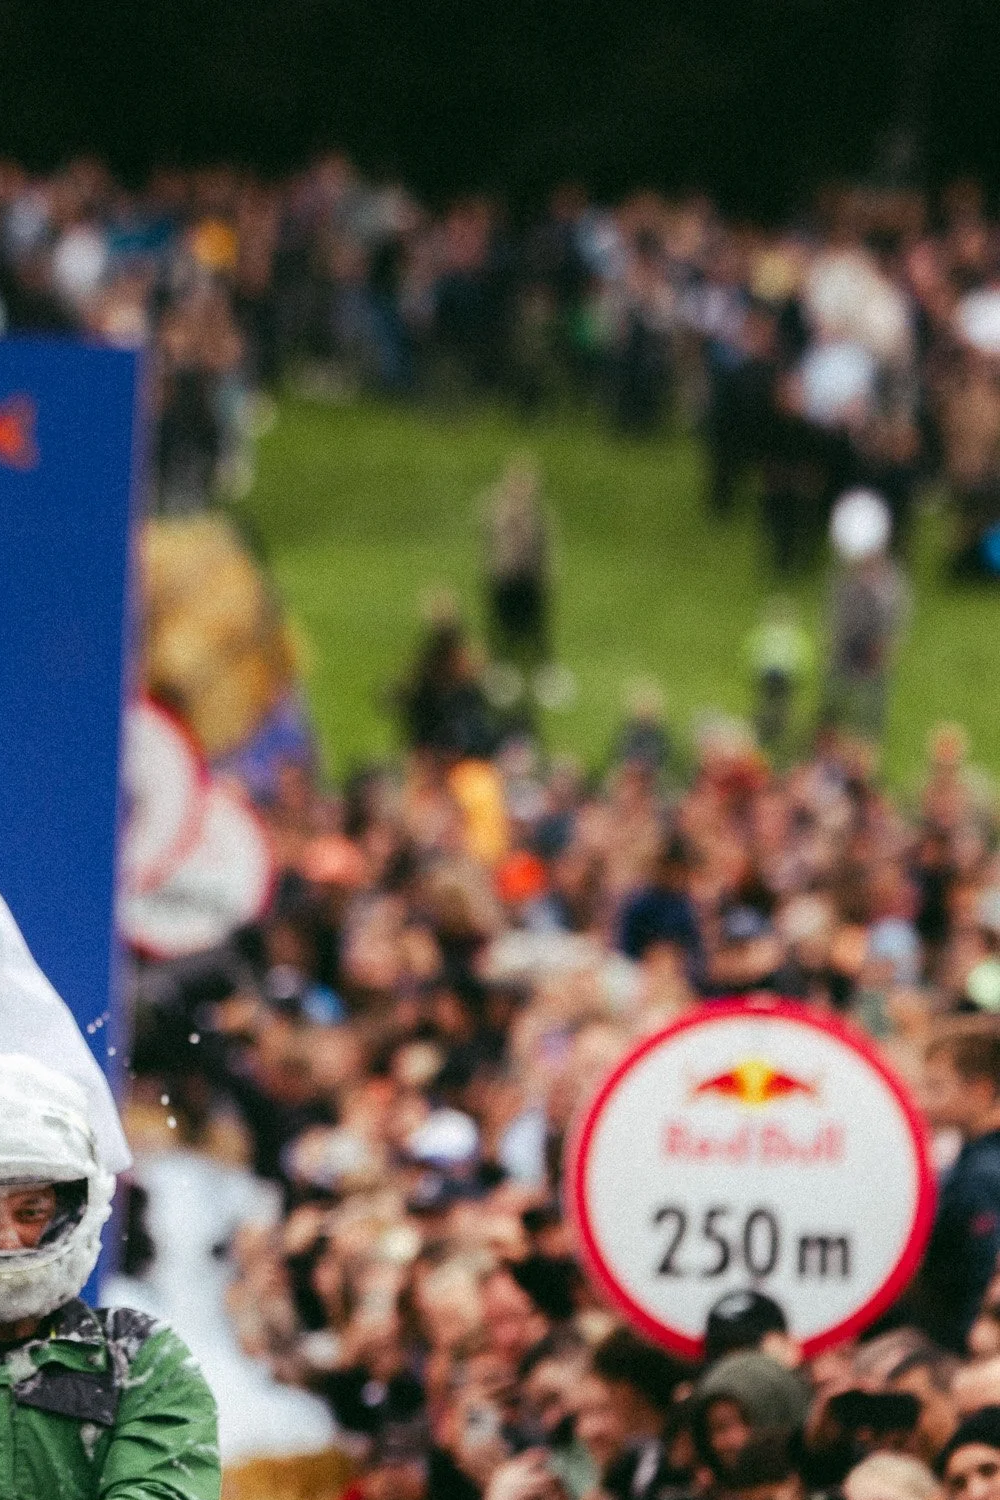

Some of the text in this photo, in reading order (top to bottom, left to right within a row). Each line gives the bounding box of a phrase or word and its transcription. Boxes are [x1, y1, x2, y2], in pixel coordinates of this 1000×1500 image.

[664, 1119, 844, 1164] Red Bull
[653, 1206, 850, 1278] 250 m
